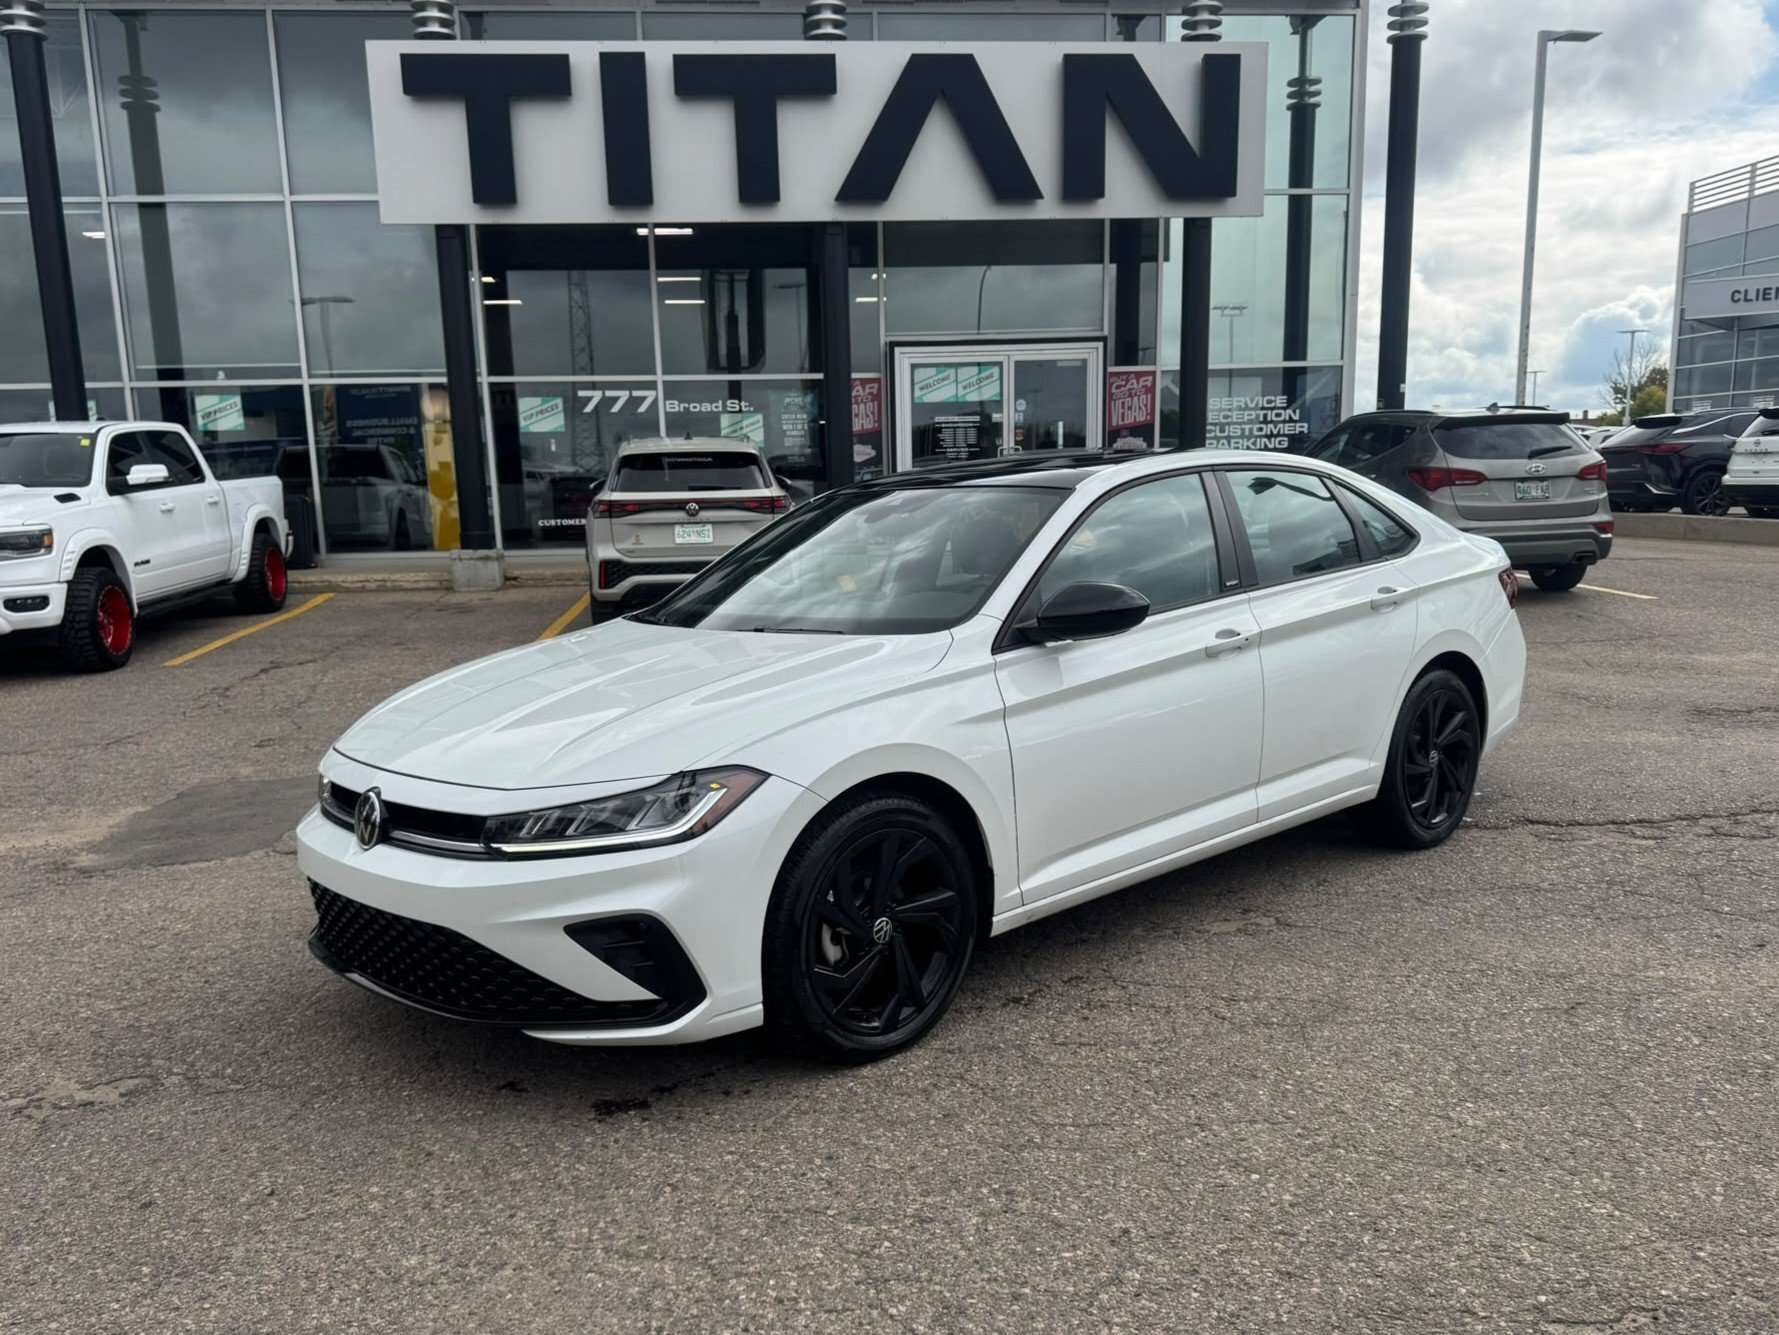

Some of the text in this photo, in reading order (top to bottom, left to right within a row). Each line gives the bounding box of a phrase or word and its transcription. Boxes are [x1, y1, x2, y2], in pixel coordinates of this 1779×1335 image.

[399, 51, 1241, 207] TITAN
[1731, 286, 1779, 303] CLIE
[851, 383, 879, 396] AR
[577, 390, 754, 413] 777 Broad St.
[1208, 396, 1288, 409] SERVICE
[852, 400, 878, 431] GAS!
[1111, 394, 1152, 426] VEGAS!
[1207, 409, 1300, 423] ECEPTION
[1206, 422, 1309, 437] CUSTOMER
[1205, 437, 1289, 449] PARKING
